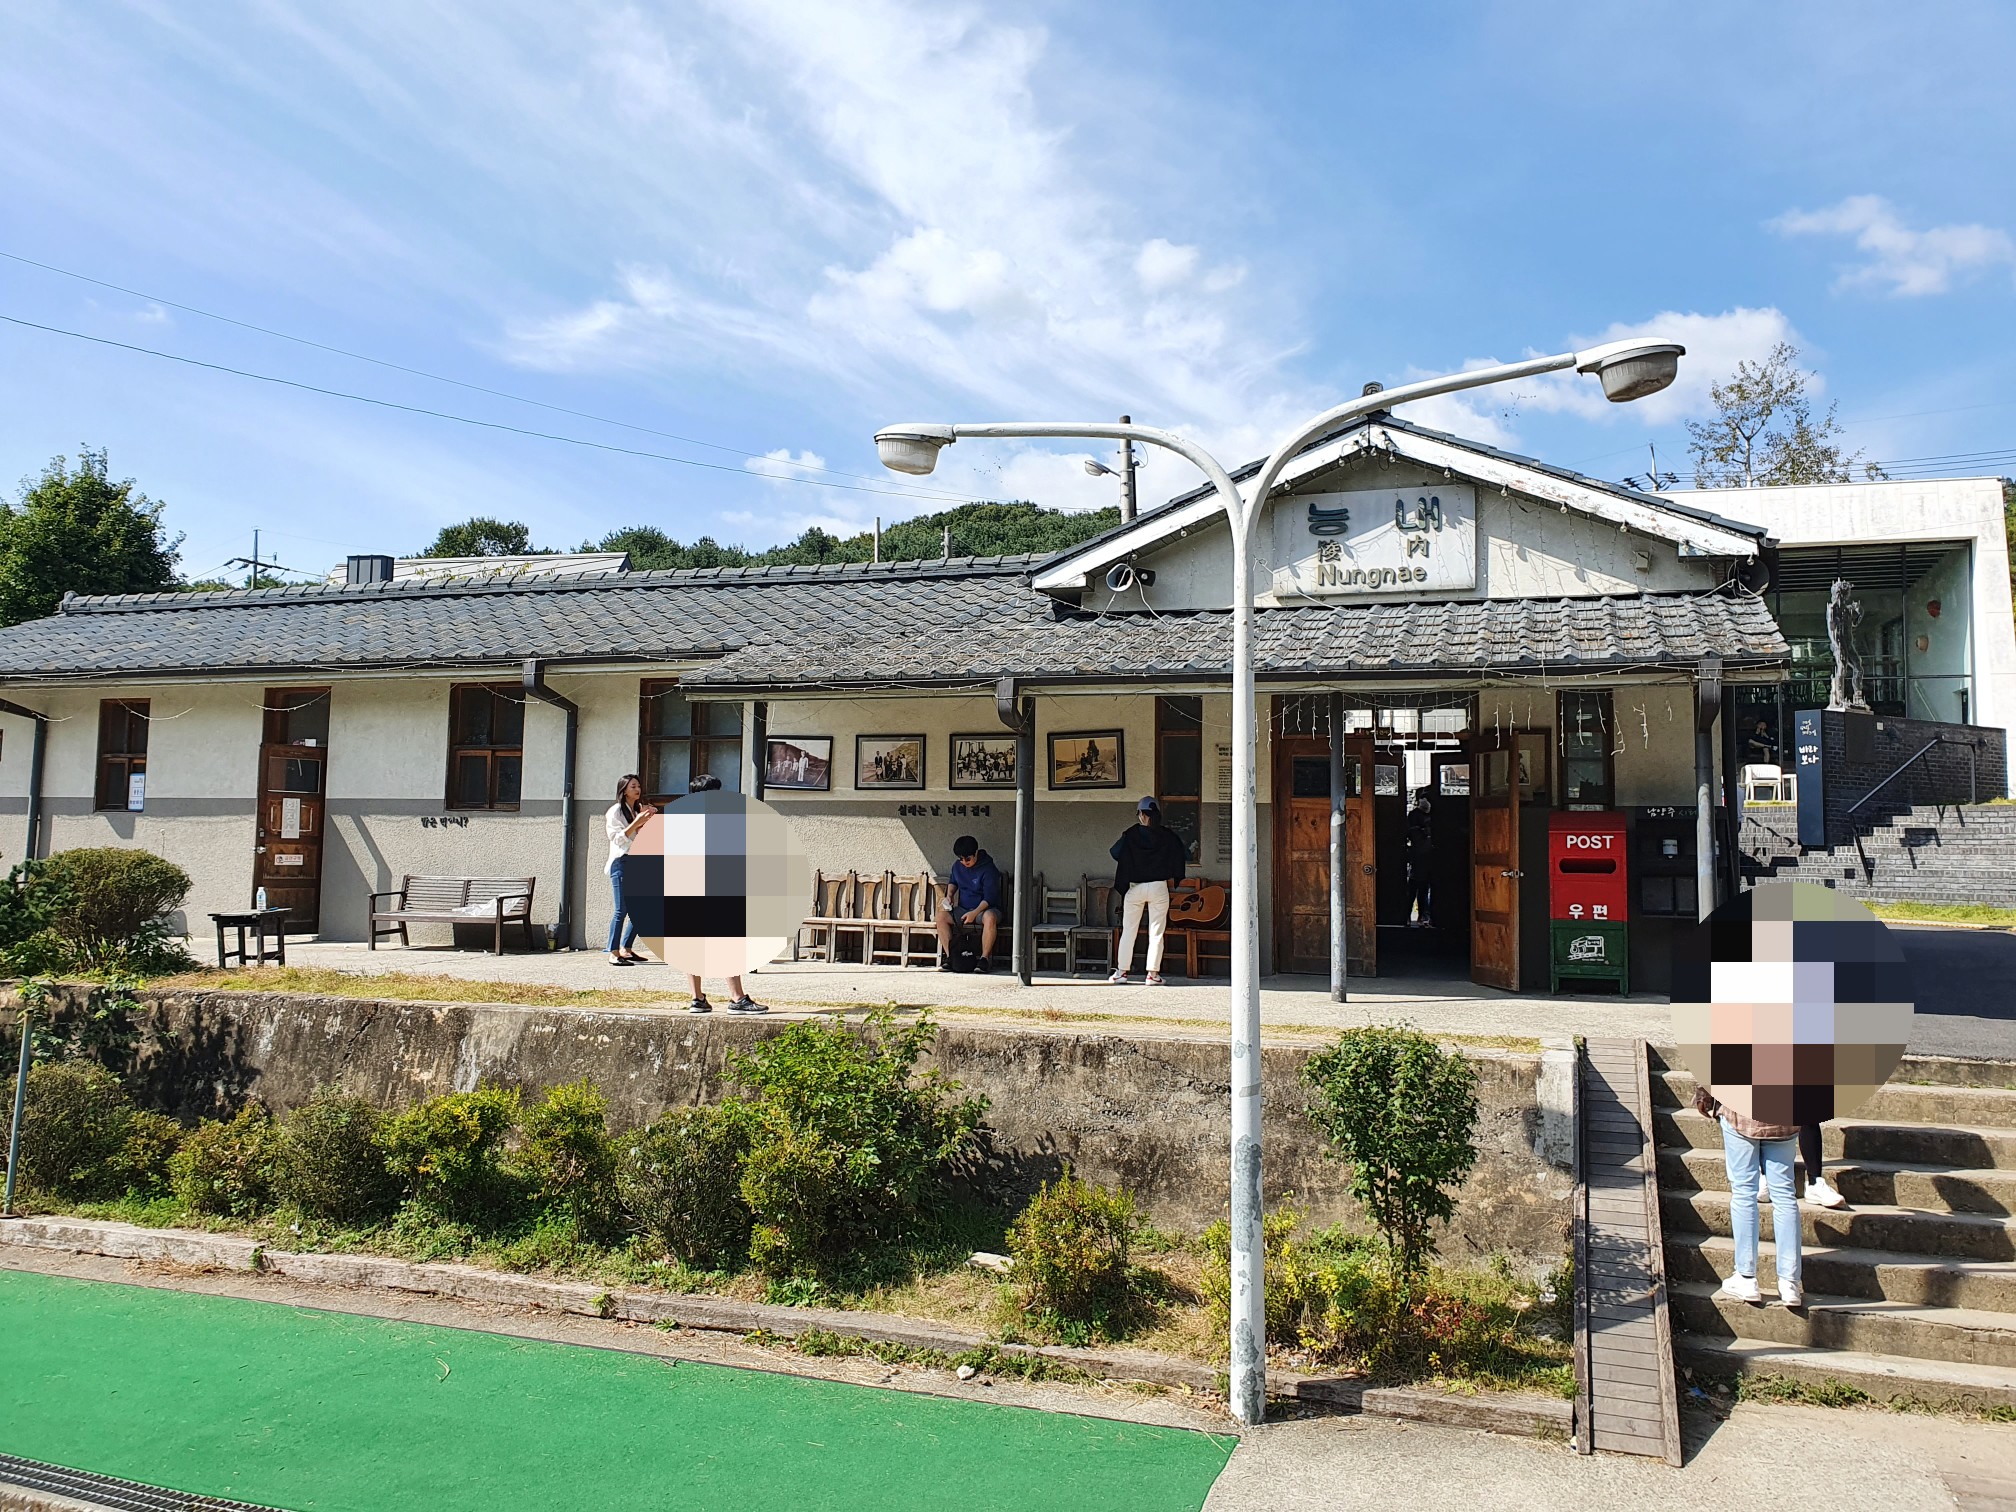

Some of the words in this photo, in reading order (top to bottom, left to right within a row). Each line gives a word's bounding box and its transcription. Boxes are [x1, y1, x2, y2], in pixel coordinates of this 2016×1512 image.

[1317, 563, 1428, 588] Nungnae
[898, 804, 927, 817] 설레는
[947, 804, 967, 817] 너의
[970, 804, 991, 817] 곁에
[1647, 807, 1675, 817] 남양주
[1566, 835, 1614, 849] POST
